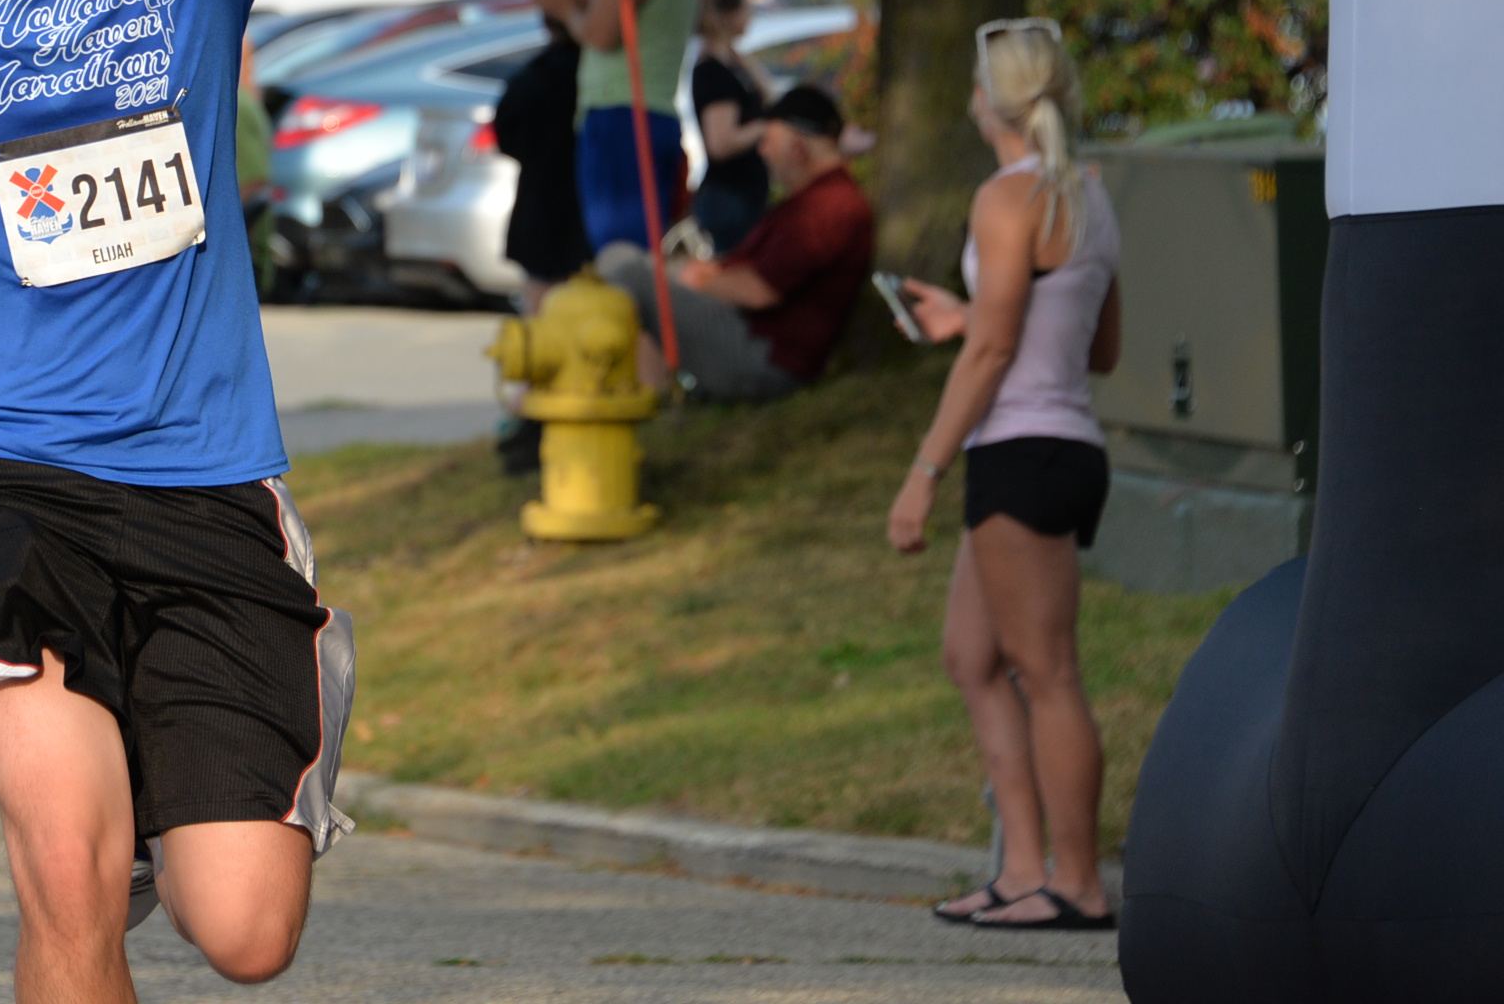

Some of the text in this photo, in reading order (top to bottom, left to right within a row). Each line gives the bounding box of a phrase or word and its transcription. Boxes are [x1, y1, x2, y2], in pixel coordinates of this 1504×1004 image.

[33, 14, 162, 66] Haven
[115, 75, 169, 110] 2021
[71, 152, 193, 230] 2141
[92, 242, 134, 264] ELIJAH
